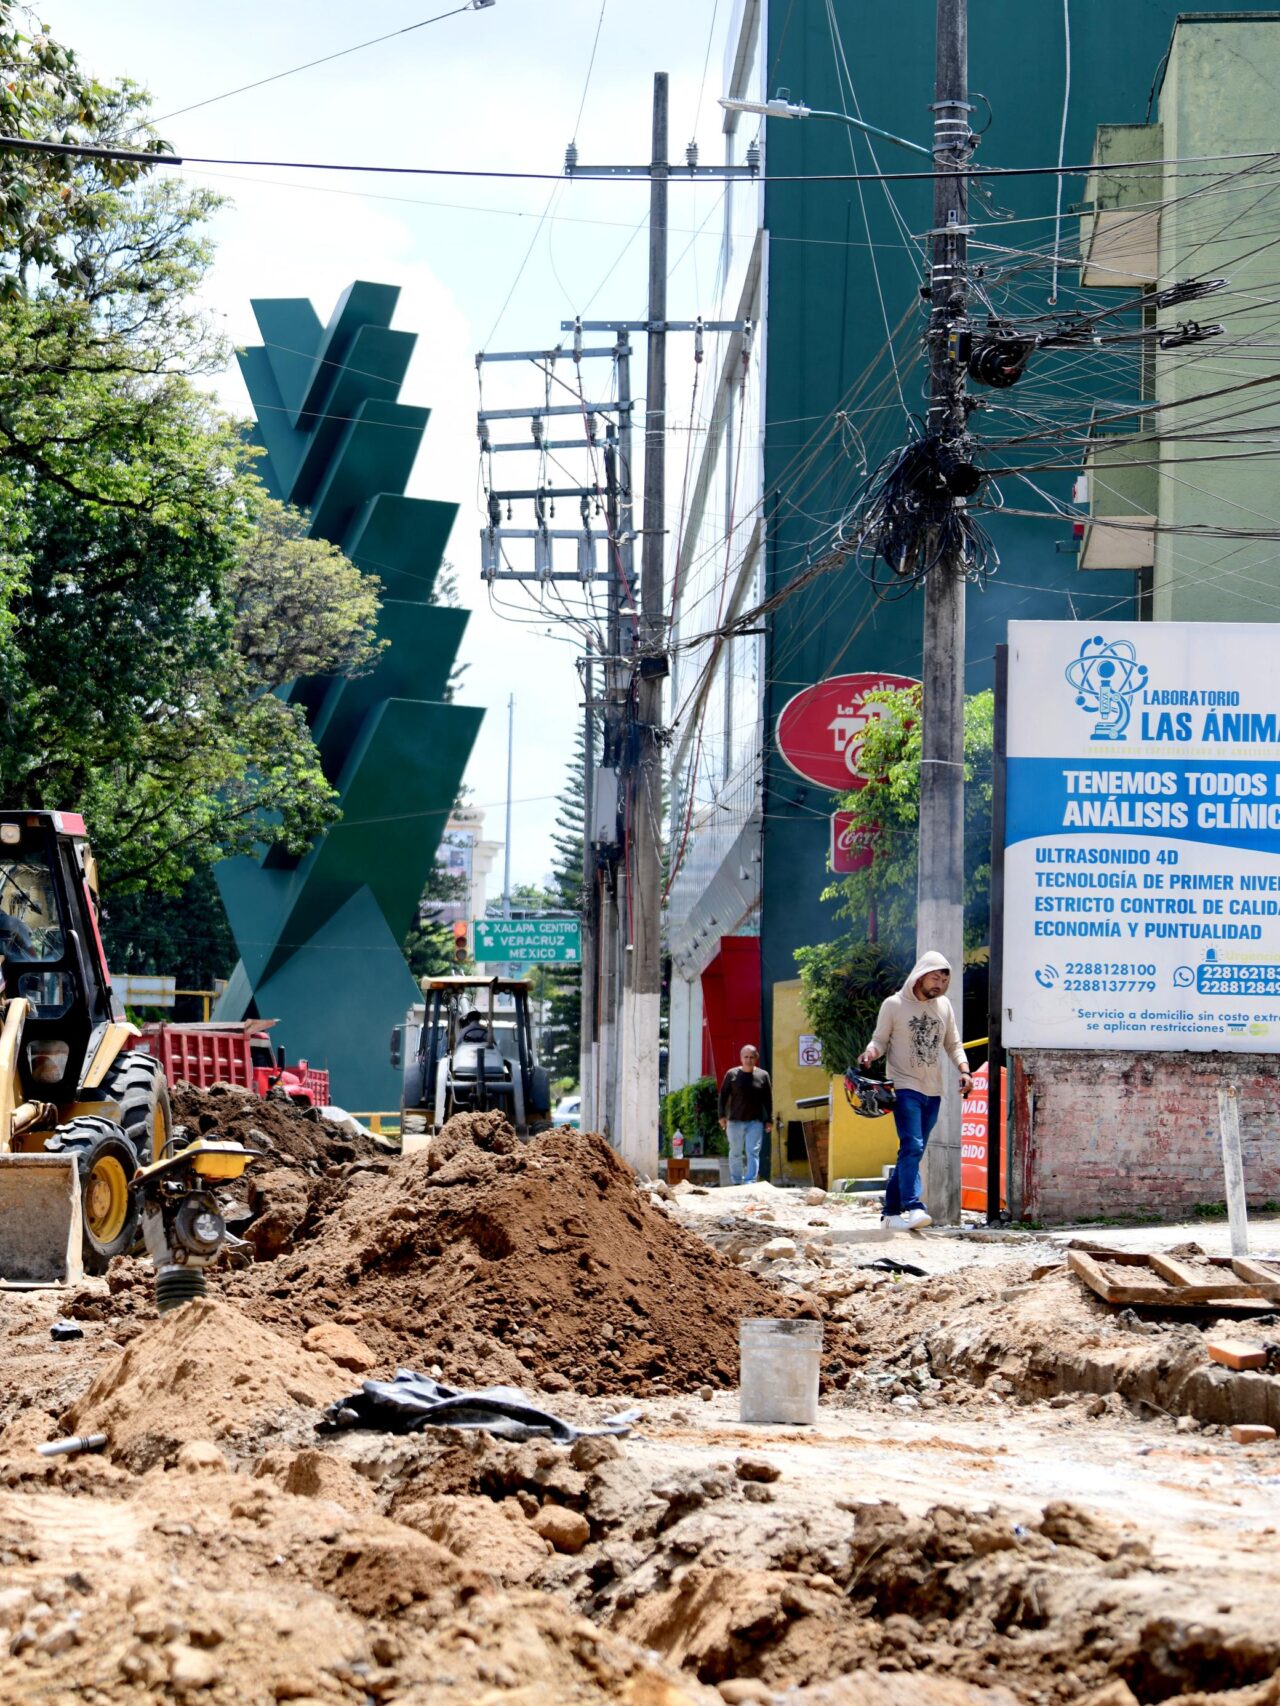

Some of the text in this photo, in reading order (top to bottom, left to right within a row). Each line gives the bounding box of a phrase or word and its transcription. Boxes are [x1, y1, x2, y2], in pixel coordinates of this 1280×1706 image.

[1143, 690, 1239, 706] LABORATORIO
[837, 704, 854, 715] La
[1141, 708, 1280, 743] LAS ÁNIM
[1062, 770, 1177, 796] TENEMOS
[1185, 772, 1268, 797] TODOS
[1062, 796, 1189, 828] ANÁLISIS
[1035, 848, 1179, 865] ULTRASONIDO 4D
[1035, 870, 1280, 891] TECNOLOGÍA DE PRIMER NIVE
[1034, 897, 1280, 915] ESTRICTO CONTROL DE CALID
[494, 923, 578, 933] XALAPA CENTRO
[1034, 919, 1262, 940] ECONOMÍA Y PUNTUALIDAD
[500, 936, 565, 946] VERACRUZ
[509, 948, 556, 959] MEXICO
[1065, 963, 1157, 976] 2288128100
[1063, 979, 1156, 992] 2288137779
[1077, 1008, 1280, 1022] Servicio a domicilio sin costo extr
[1086, 1022, 1099, 1030] se
[1103, 1020, 1146, 1033] aplican
[1150, 1022, 1225, 1033] restricciones
